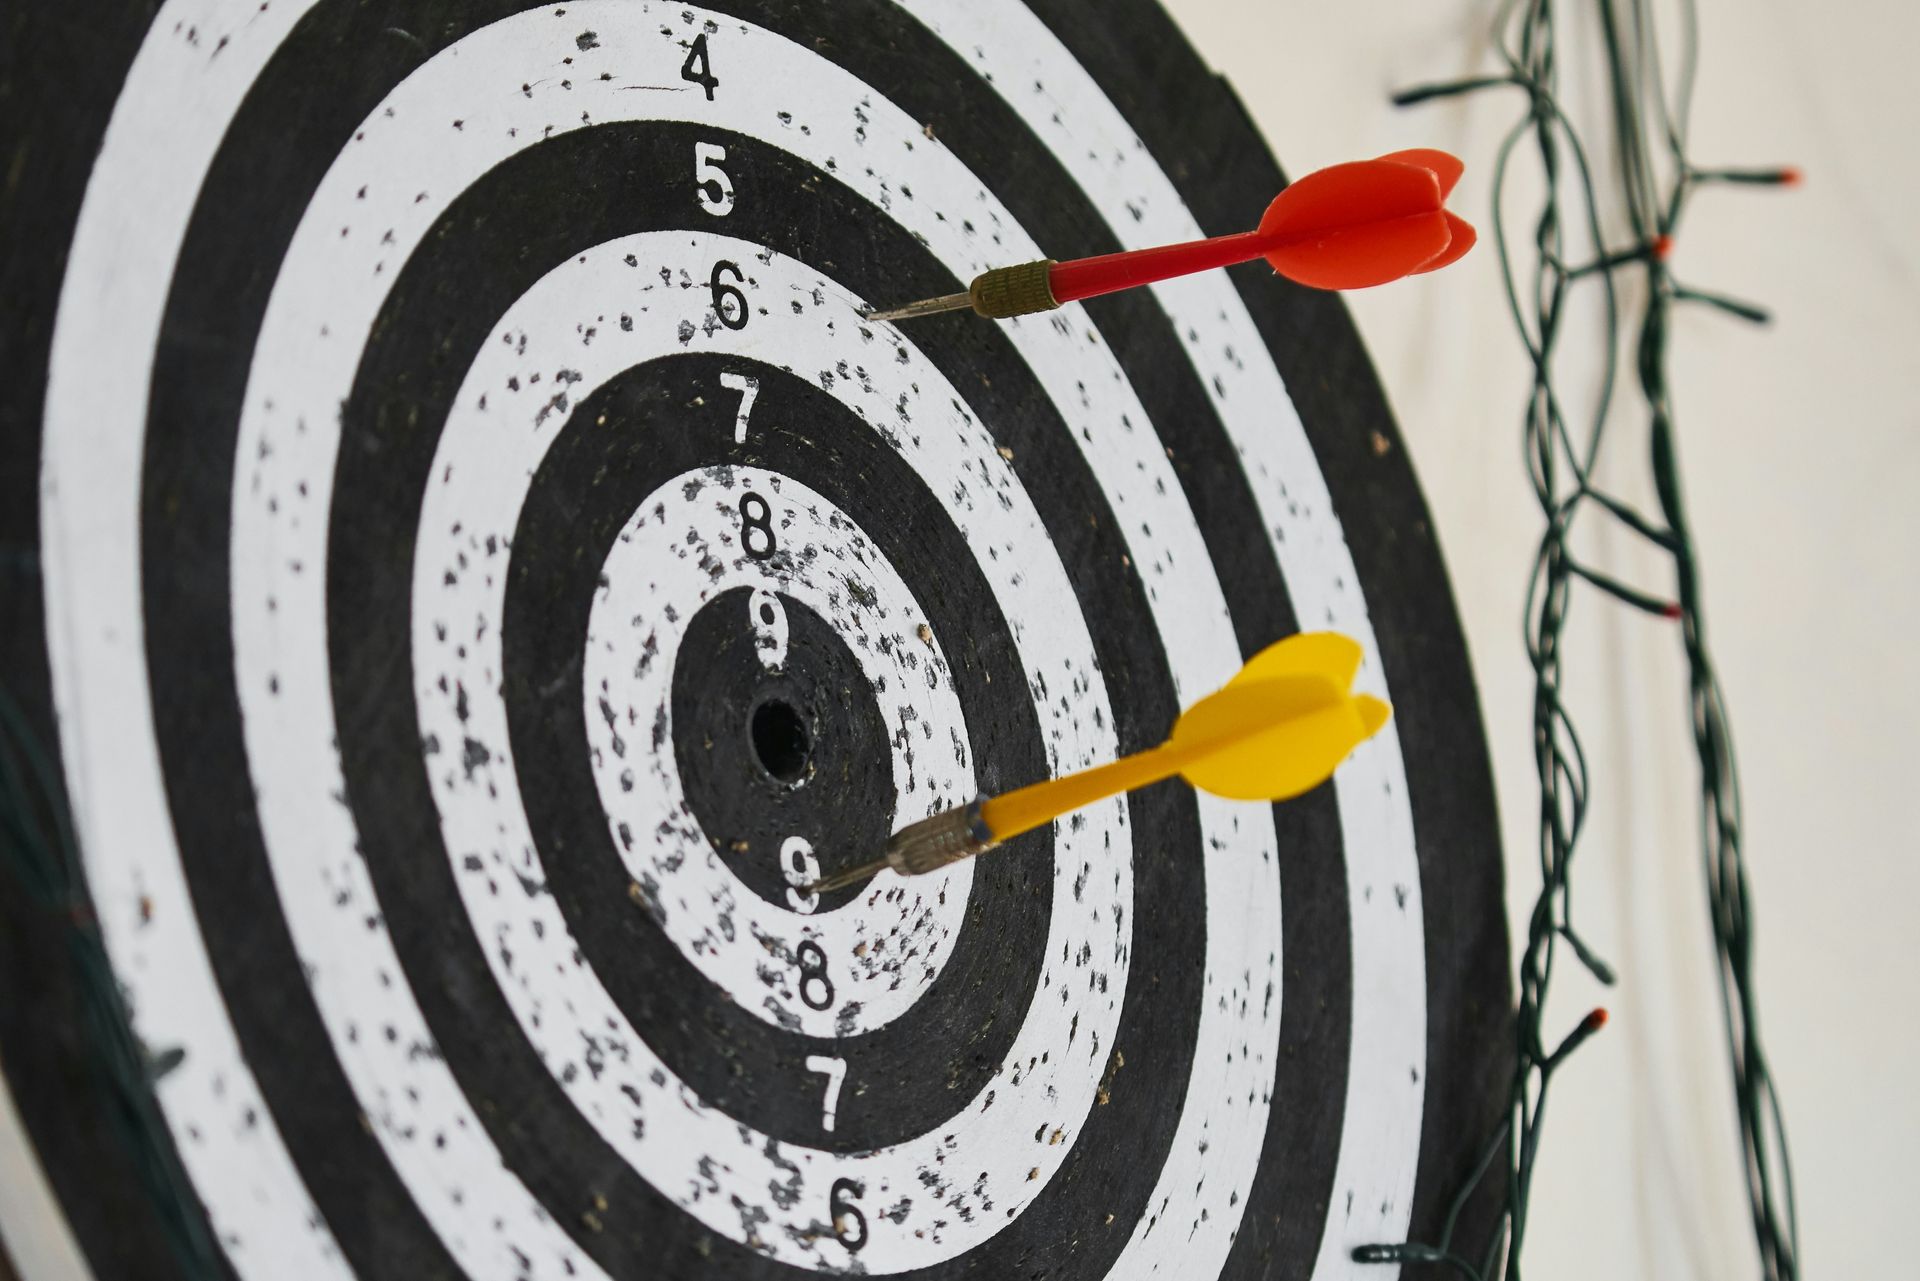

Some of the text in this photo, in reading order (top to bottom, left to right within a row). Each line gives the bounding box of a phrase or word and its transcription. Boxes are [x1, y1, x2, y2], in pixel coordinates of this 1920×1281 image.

[681, 33, 719, 101] 4
[694, 142, 736, 216] 5
[711, 260, 749, 331] 6
[720, 373, 759, 443] 7
[739, 491, 776, 560] 8
[749, 588, 789, 672] 9
[779, 835, 820, 915] 9
[796, 940, 834, 1011] 8
[805, 1055, 846, 1132] 7
[829, 1178, 868, 1251] 6
